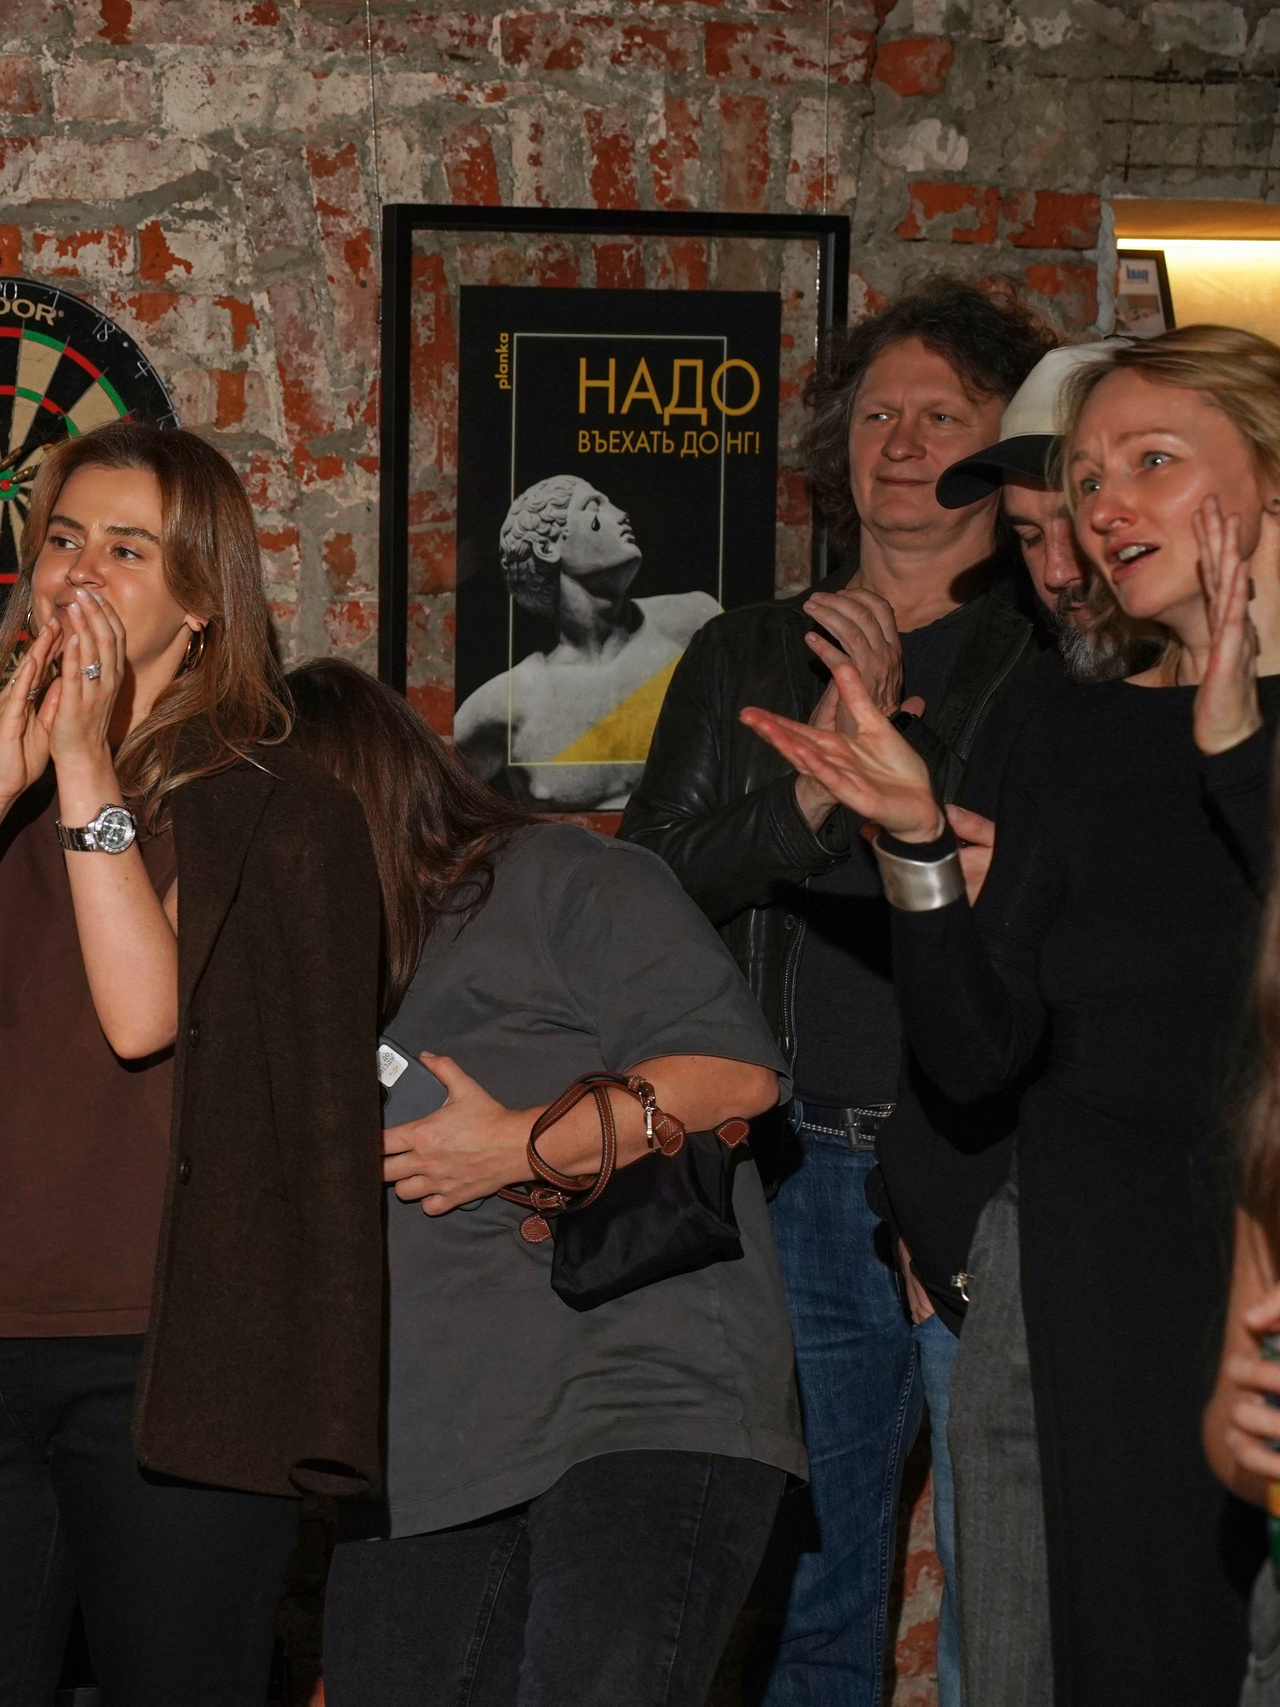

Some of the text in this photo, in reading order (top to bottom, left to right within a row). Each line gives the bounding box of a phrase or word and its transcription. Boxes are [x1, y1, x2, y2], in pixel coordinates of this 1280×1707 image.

[91, 315, 116, 342] 18
[494, 332, 512, 389] planka
[578, 355, 761, 426] НАДО
[578, 430, 760, 458] ВЪЕХАТЬ ДО НГ!
